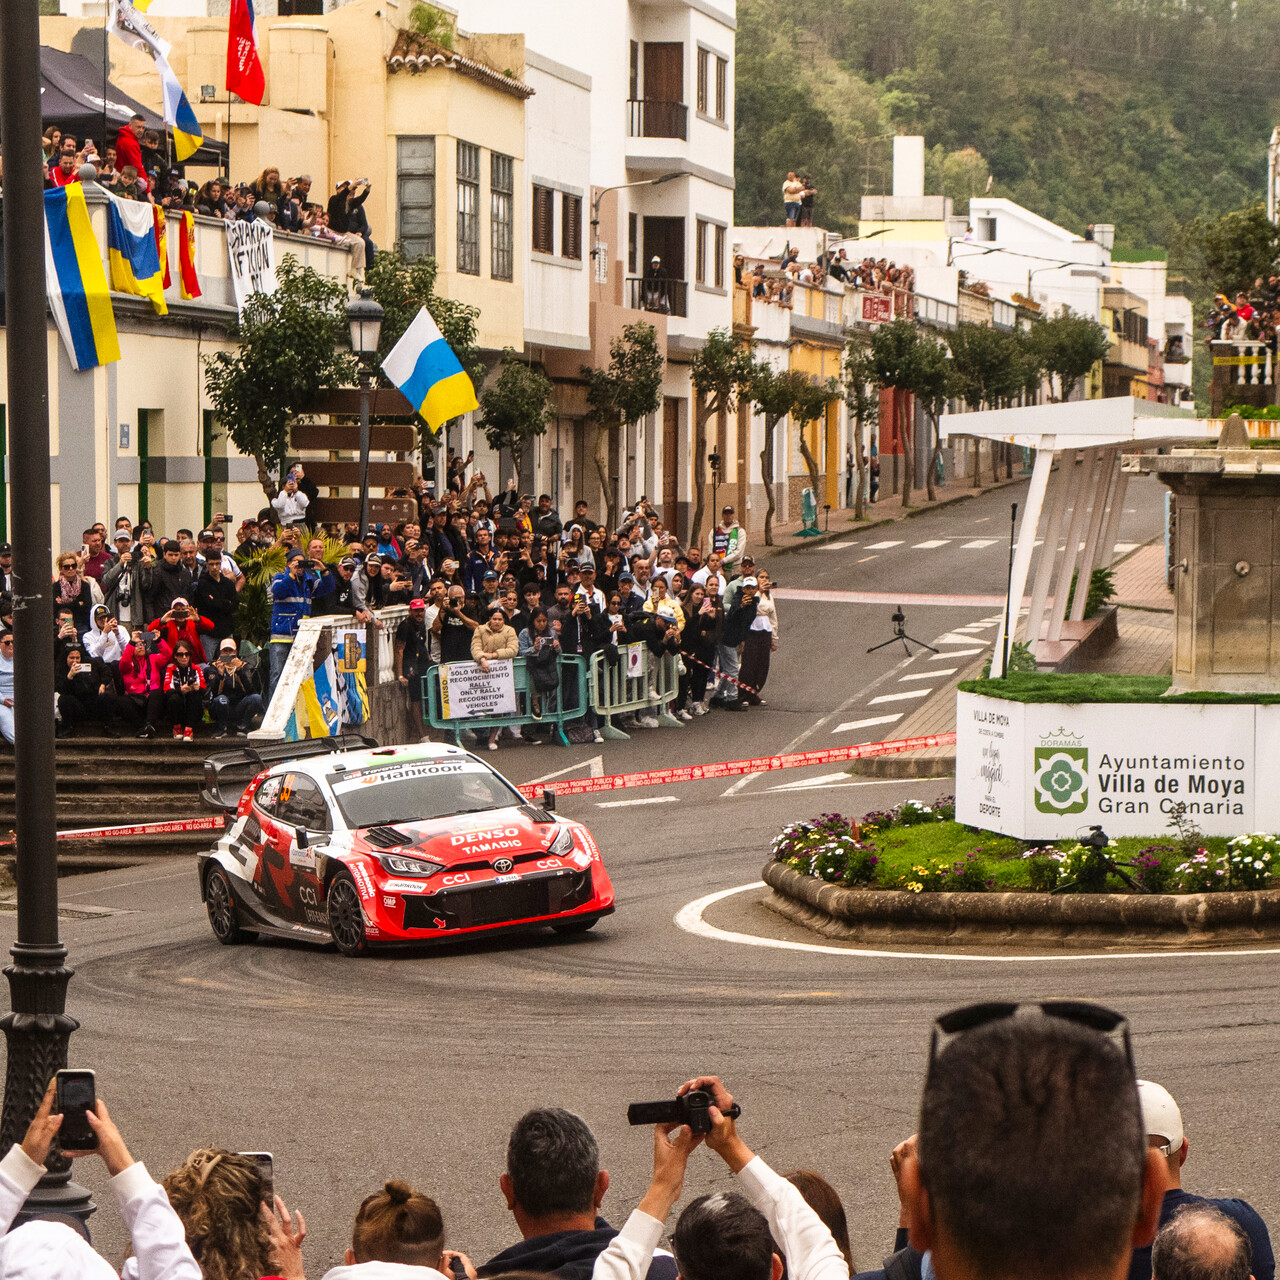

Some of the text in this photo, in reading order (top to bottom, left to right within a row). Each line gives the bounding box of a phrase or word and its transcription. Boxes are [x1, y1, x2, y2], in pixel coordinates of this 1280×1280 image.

[470, 665, 508, 675] VEHULOS
[449, 673, 510, 684] RECONOCIMIENTO
[441, 679, 450, 705] AVISO
[458, 694, 504, 703] RECOGNITION
[465, 701, 498, 709] VEHICLES
[973, 710, 1010, 726] VILLA DE MOYA
[806, 751, 828, 759] PROHIBIDO
[830, 748, 848, 756] PUBLICO
[1099, 754, 1245, 772] Ayuntamiento
[648, 770, 672, 778] PROHIBIDO
[570, 779, 593, 787] PROHIBIDO
[1098, 774, 1245, 798] Villa de Moya
[979, 803, 1001, 818] DEPORTE
[1098, 797, 1244, 815] Gran Canaria
[450, 827, 519, 846] DENSO
[462, 840, 522, 855] TAMADIC
[536, 859, 562, 869] CCI
[349, 863, 370, 900] AUTOMOTIVE
[356, 861, 376, 898] Panasonic
[442, 872, 470, 885] CCI
